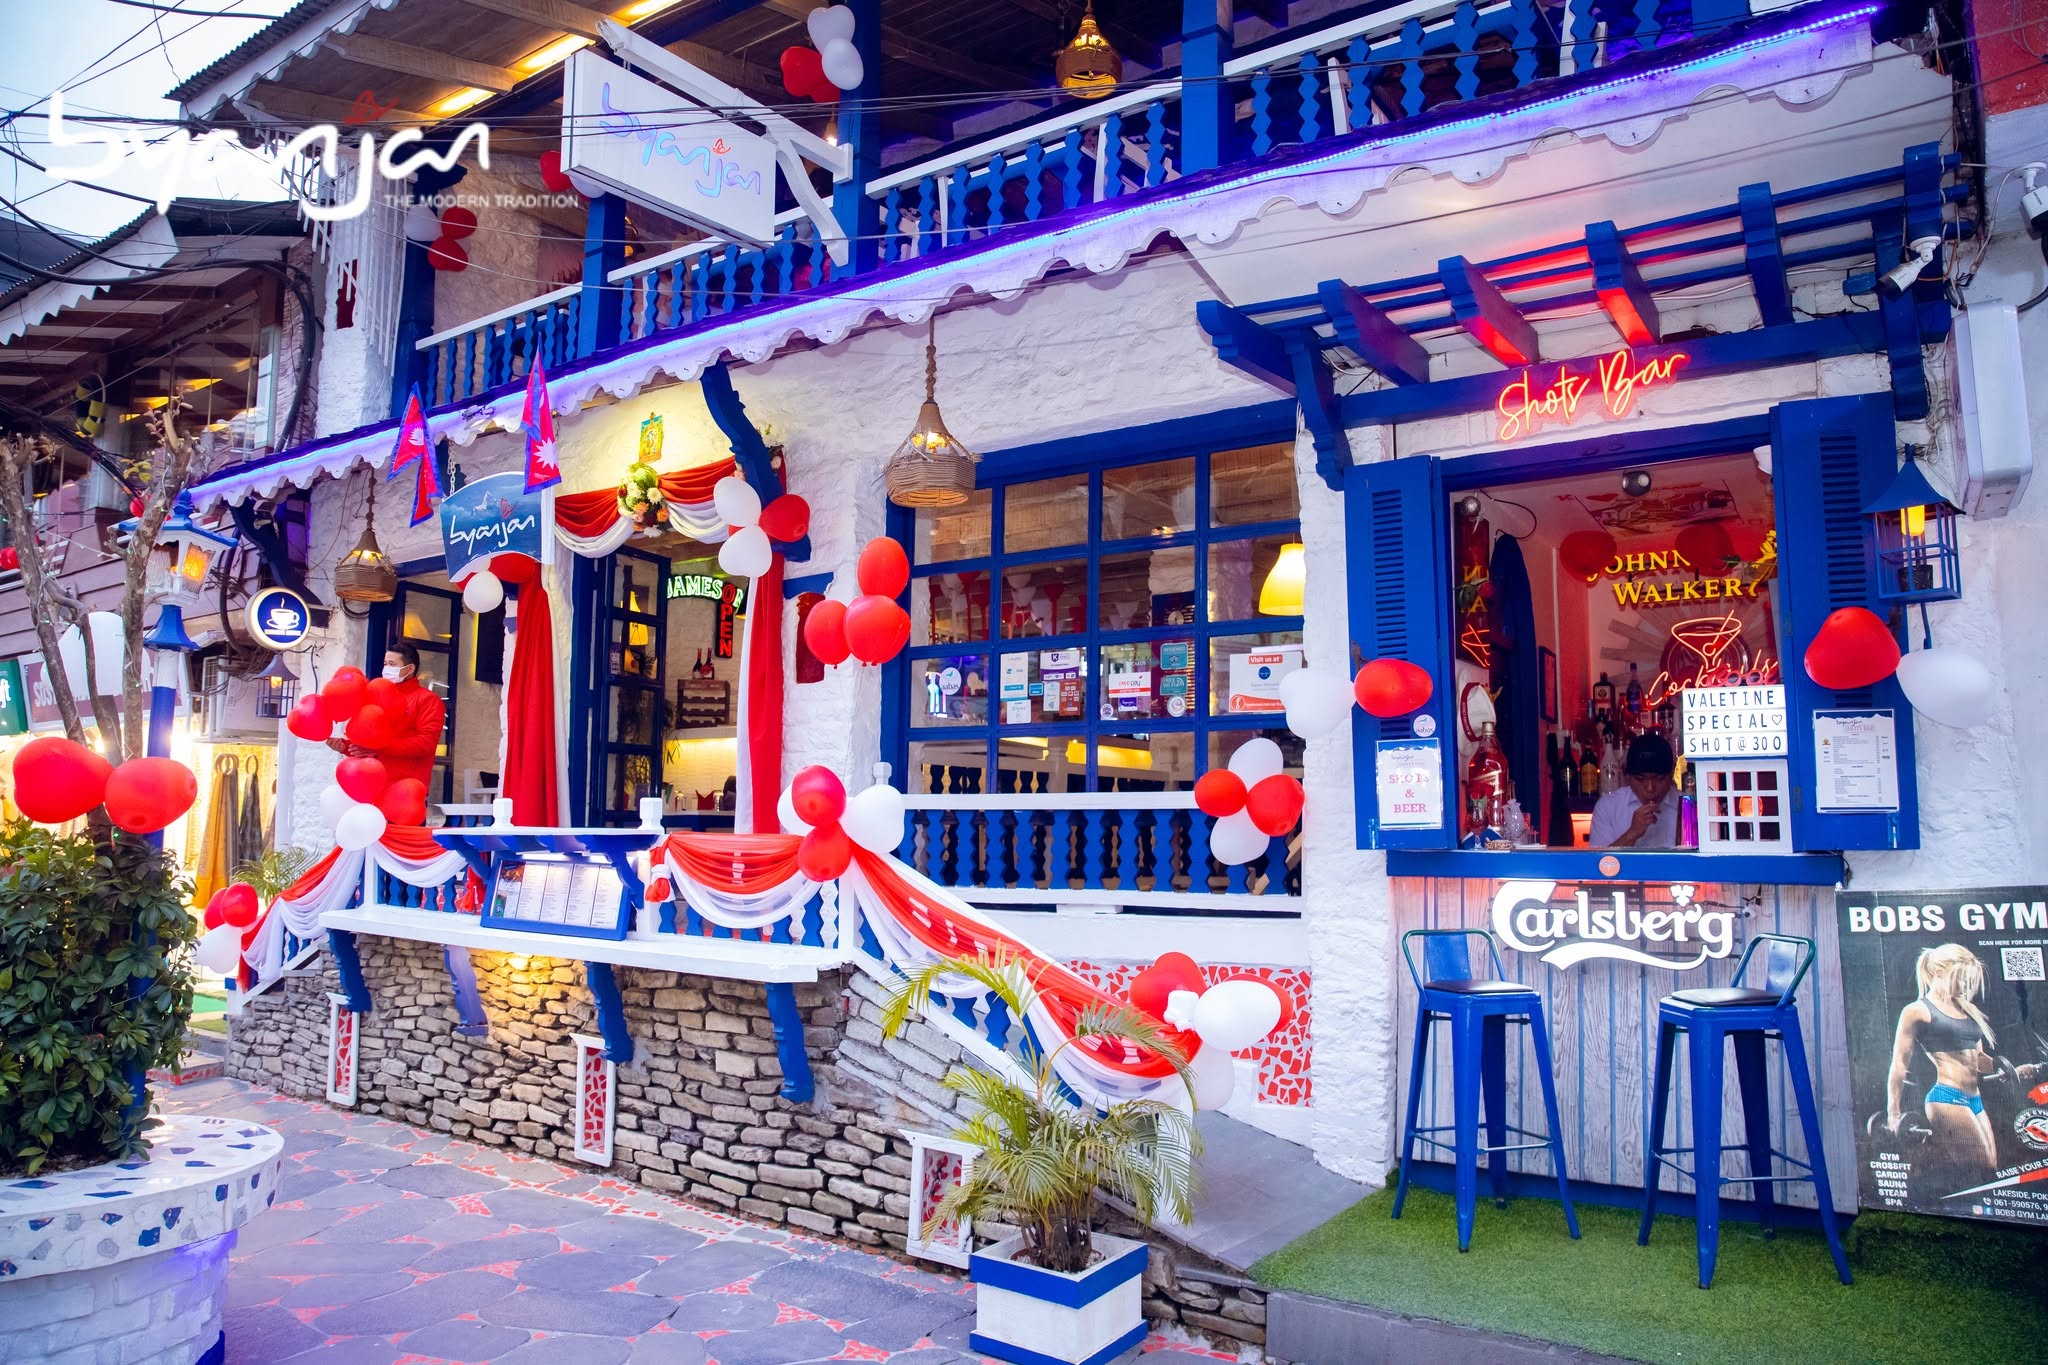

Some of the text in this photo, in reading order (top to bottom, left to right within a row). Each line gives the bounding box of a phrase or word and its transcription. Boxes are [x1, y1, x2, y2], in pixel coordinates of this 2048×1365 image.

[1499, 349, 1686, 441] Shots Bar
[666, 575, 745, 613] JAMESN
[1612, 577, 1744, 606] WALKER
[719, 583, 736, 658] OPEN
[1249, 656, 1264, 664] Visit
[1688, 690, 1774, 708] VALETINE
[1687, 713, 1768, 731] SPECIAL
[1393, 803, 1427, 813] BEER
[1848, 901, 2048, 933] BOBS GYM
[1491, 880, 1736, 971] Carlsberg
[1880, 1152, 1900, 1161] GYM
[1870, 1161, 1912, 1171] CROSSFIT
[1995, 1166, 2020, 1179] RAISE
[2018, 1160, 2043, 1173] YOUR
[1875, 1170, 1908, 1180] CARDIO
[1878, 1180, 1908, 1189] SAUNA
[1878, 1189, 1908, 1198] STEAM
[1993, 1189, 2031, 1200] LAKESIDE,
[1885, 1198, 1903, 1207] SPA
[1995, 1208, 2016, 1217] BOBS
[2016, 1210, 2035, 1219] GYM
